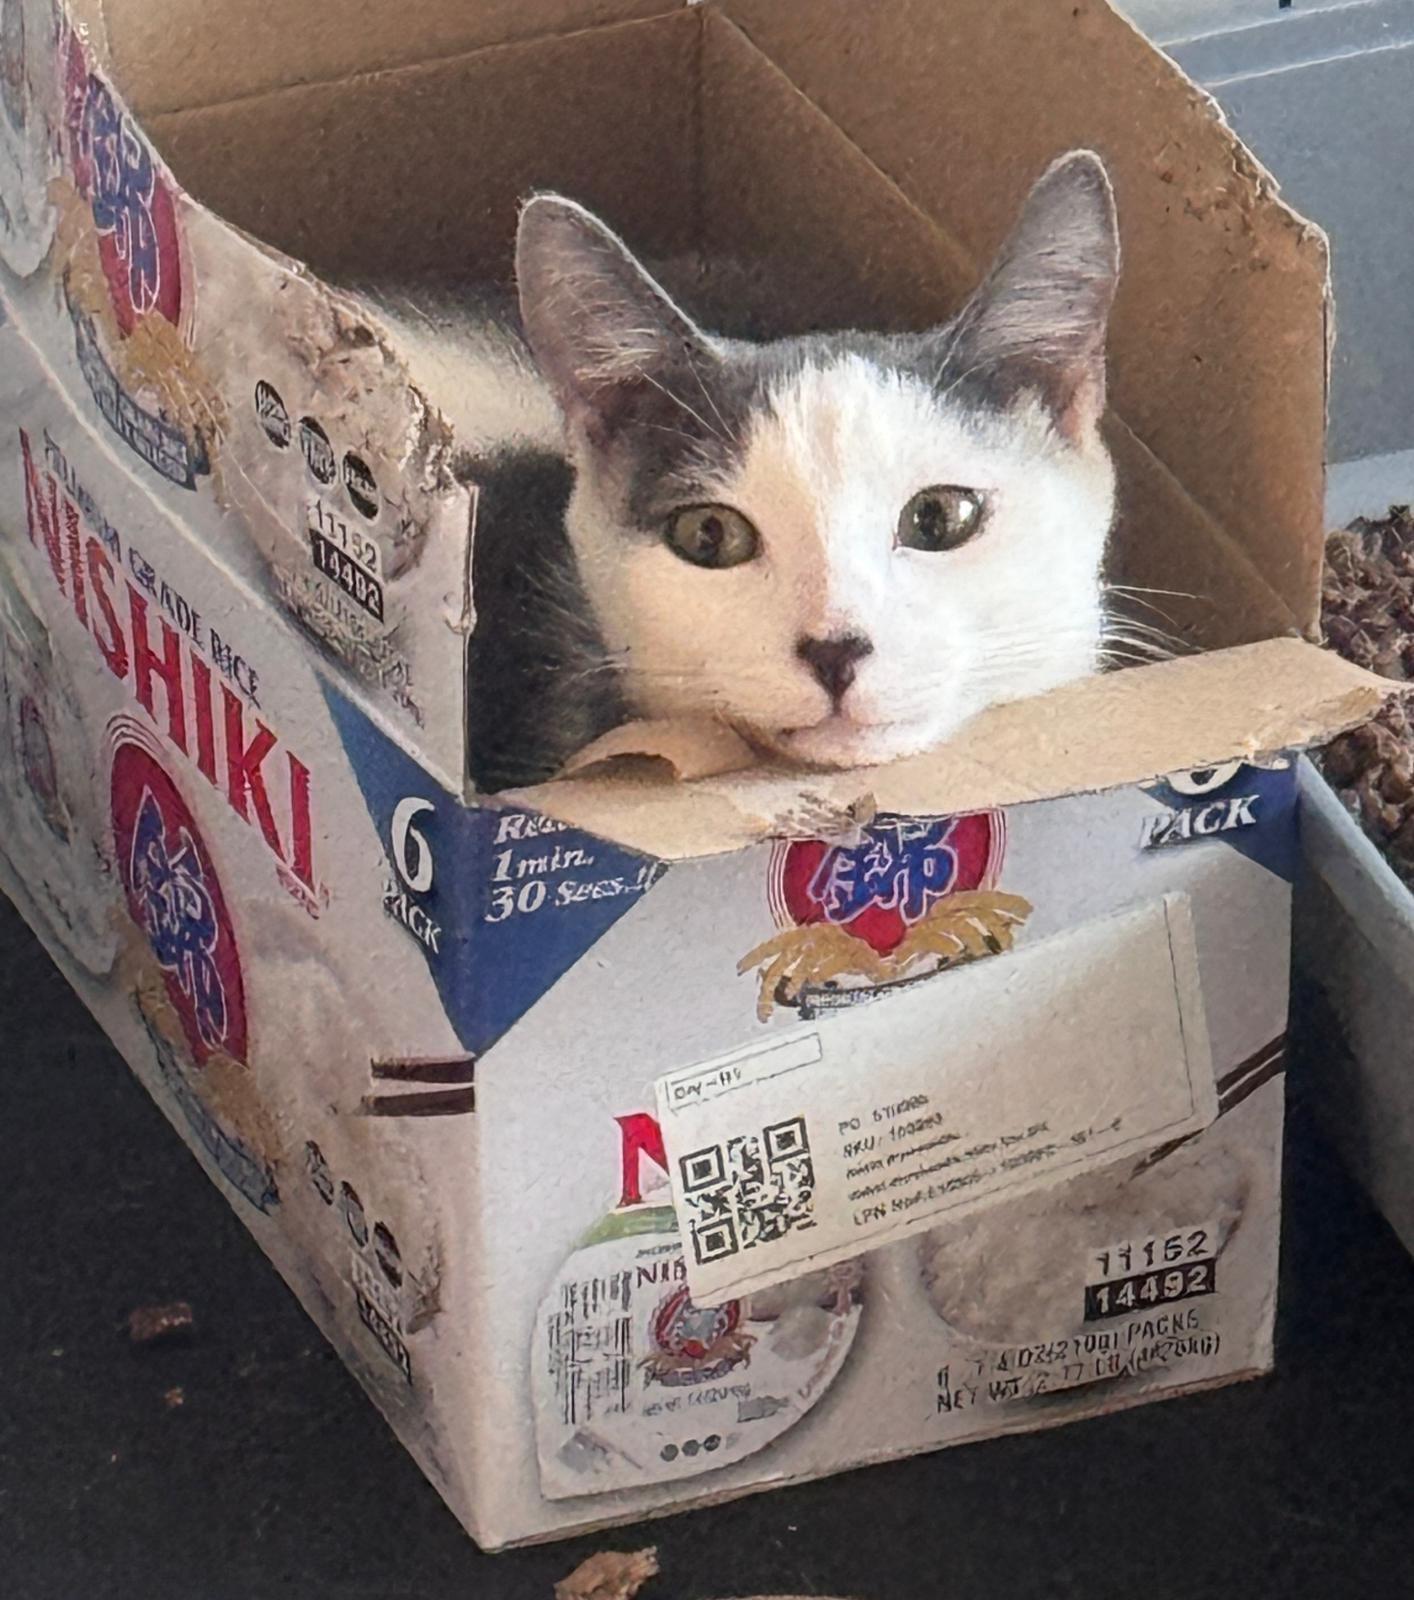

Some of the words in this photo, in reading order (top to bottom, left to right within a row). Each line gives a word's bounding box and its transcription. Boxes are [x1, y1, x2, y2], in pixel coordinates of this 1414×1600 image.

[391, 797, 435, 892] 6
[1140, 794, 1260, 849] PACK
[484, 880, 547, 922] 30
